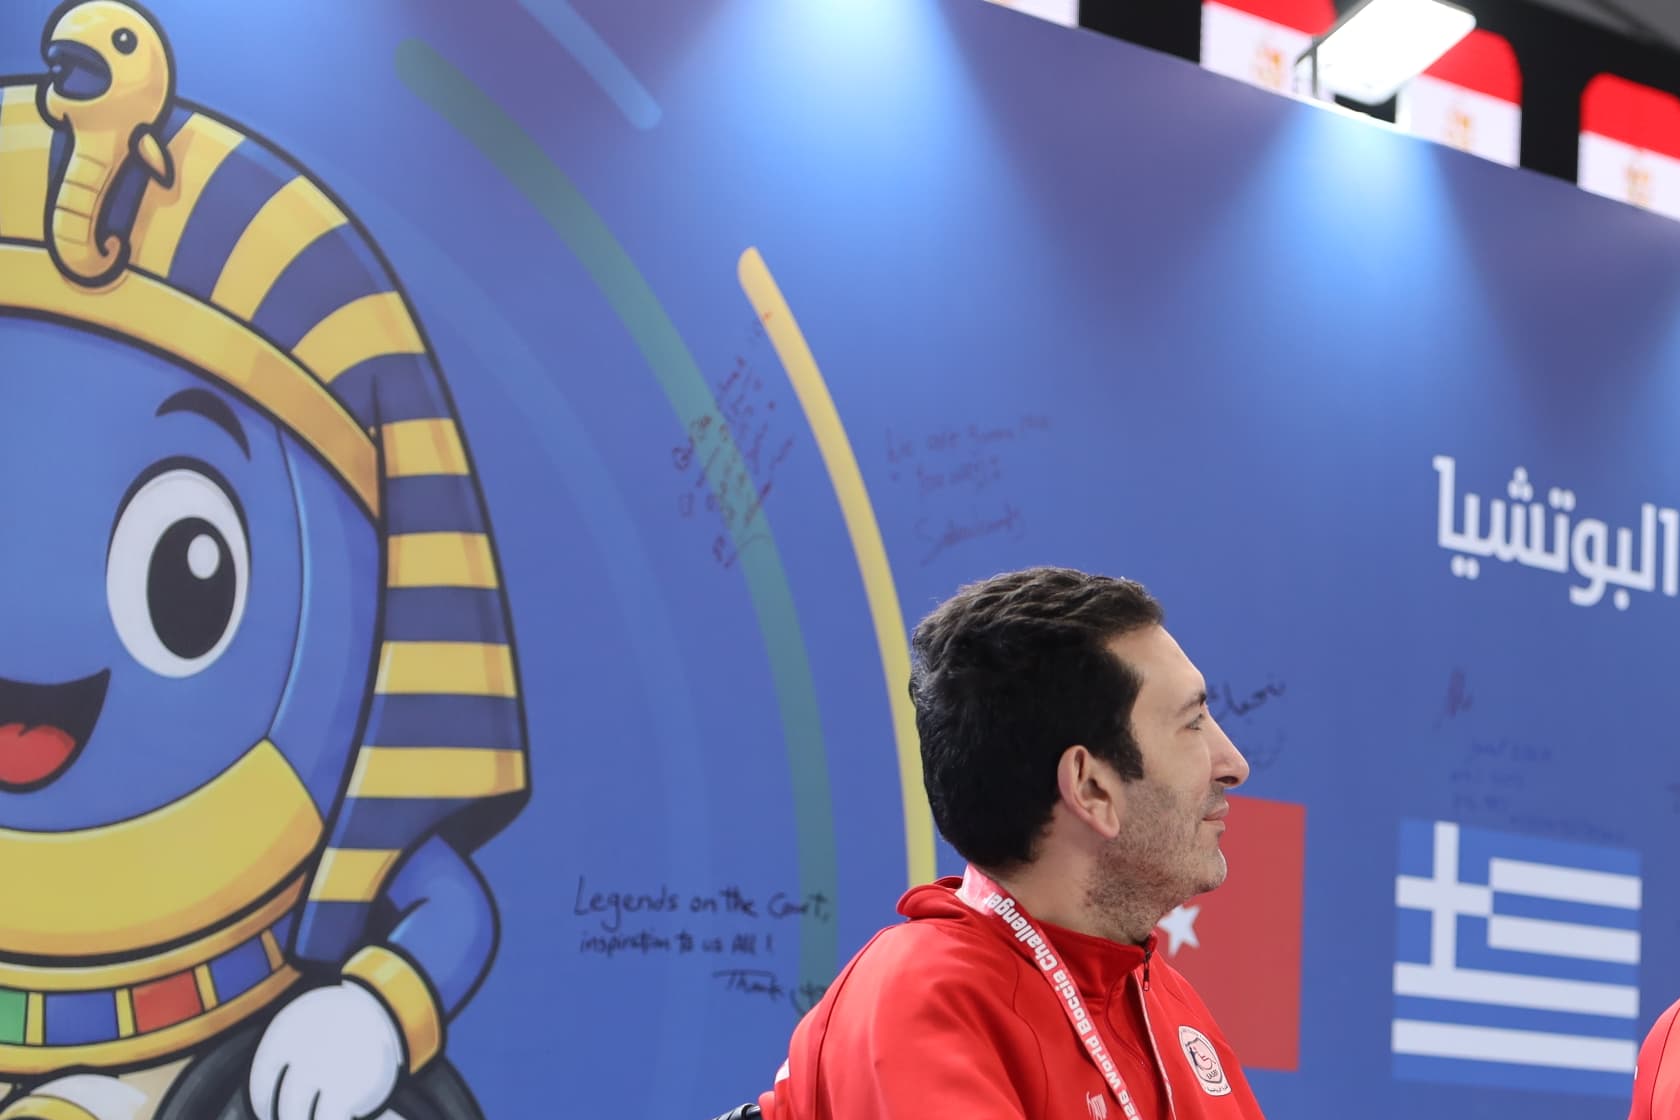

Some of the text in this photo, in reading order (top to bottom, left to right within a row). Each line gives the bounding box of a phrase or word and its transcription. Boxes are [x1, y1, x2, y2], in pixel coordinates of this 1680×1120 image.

[1433, 455, 1679, 610] البوتشيا
[574, 875, 679, 932] Legends
[690, 895, 717, 913] on
[720, 886, 757, 917] the
[984, 891, 1058, 971] Challenger
[580, 931, 670, 959] inspiration
[677, 930, 693, 954] to
[702, 937, 723, 952] us
[1053, 969, 1091, 1034] Boccia
[1085, 1036, 1122, 1089] World
